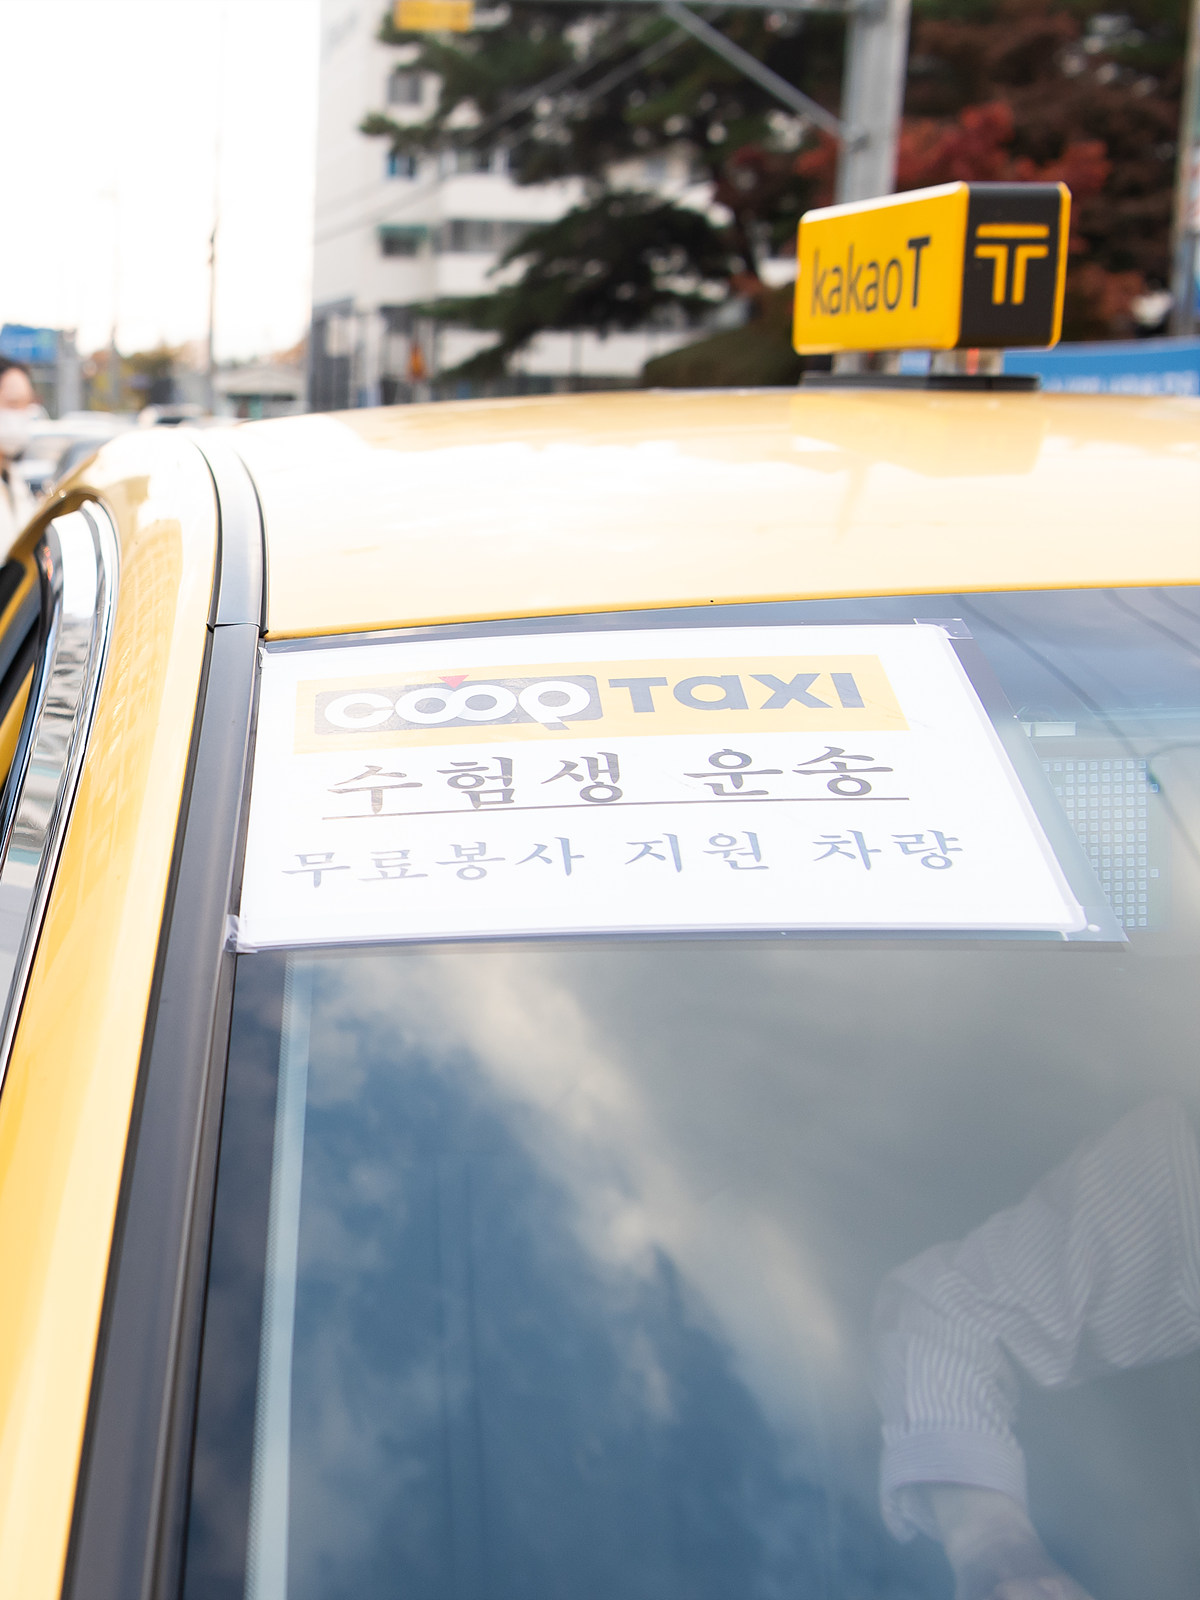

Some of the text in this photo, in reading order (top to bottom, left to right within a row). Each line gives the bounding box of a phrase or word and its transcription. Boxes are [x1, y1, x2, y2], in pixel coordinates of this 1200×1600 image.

[327, 746, 894, 815] 수험생 운송
[282, 829, 963, 889] 무료봉사 지원 차량
